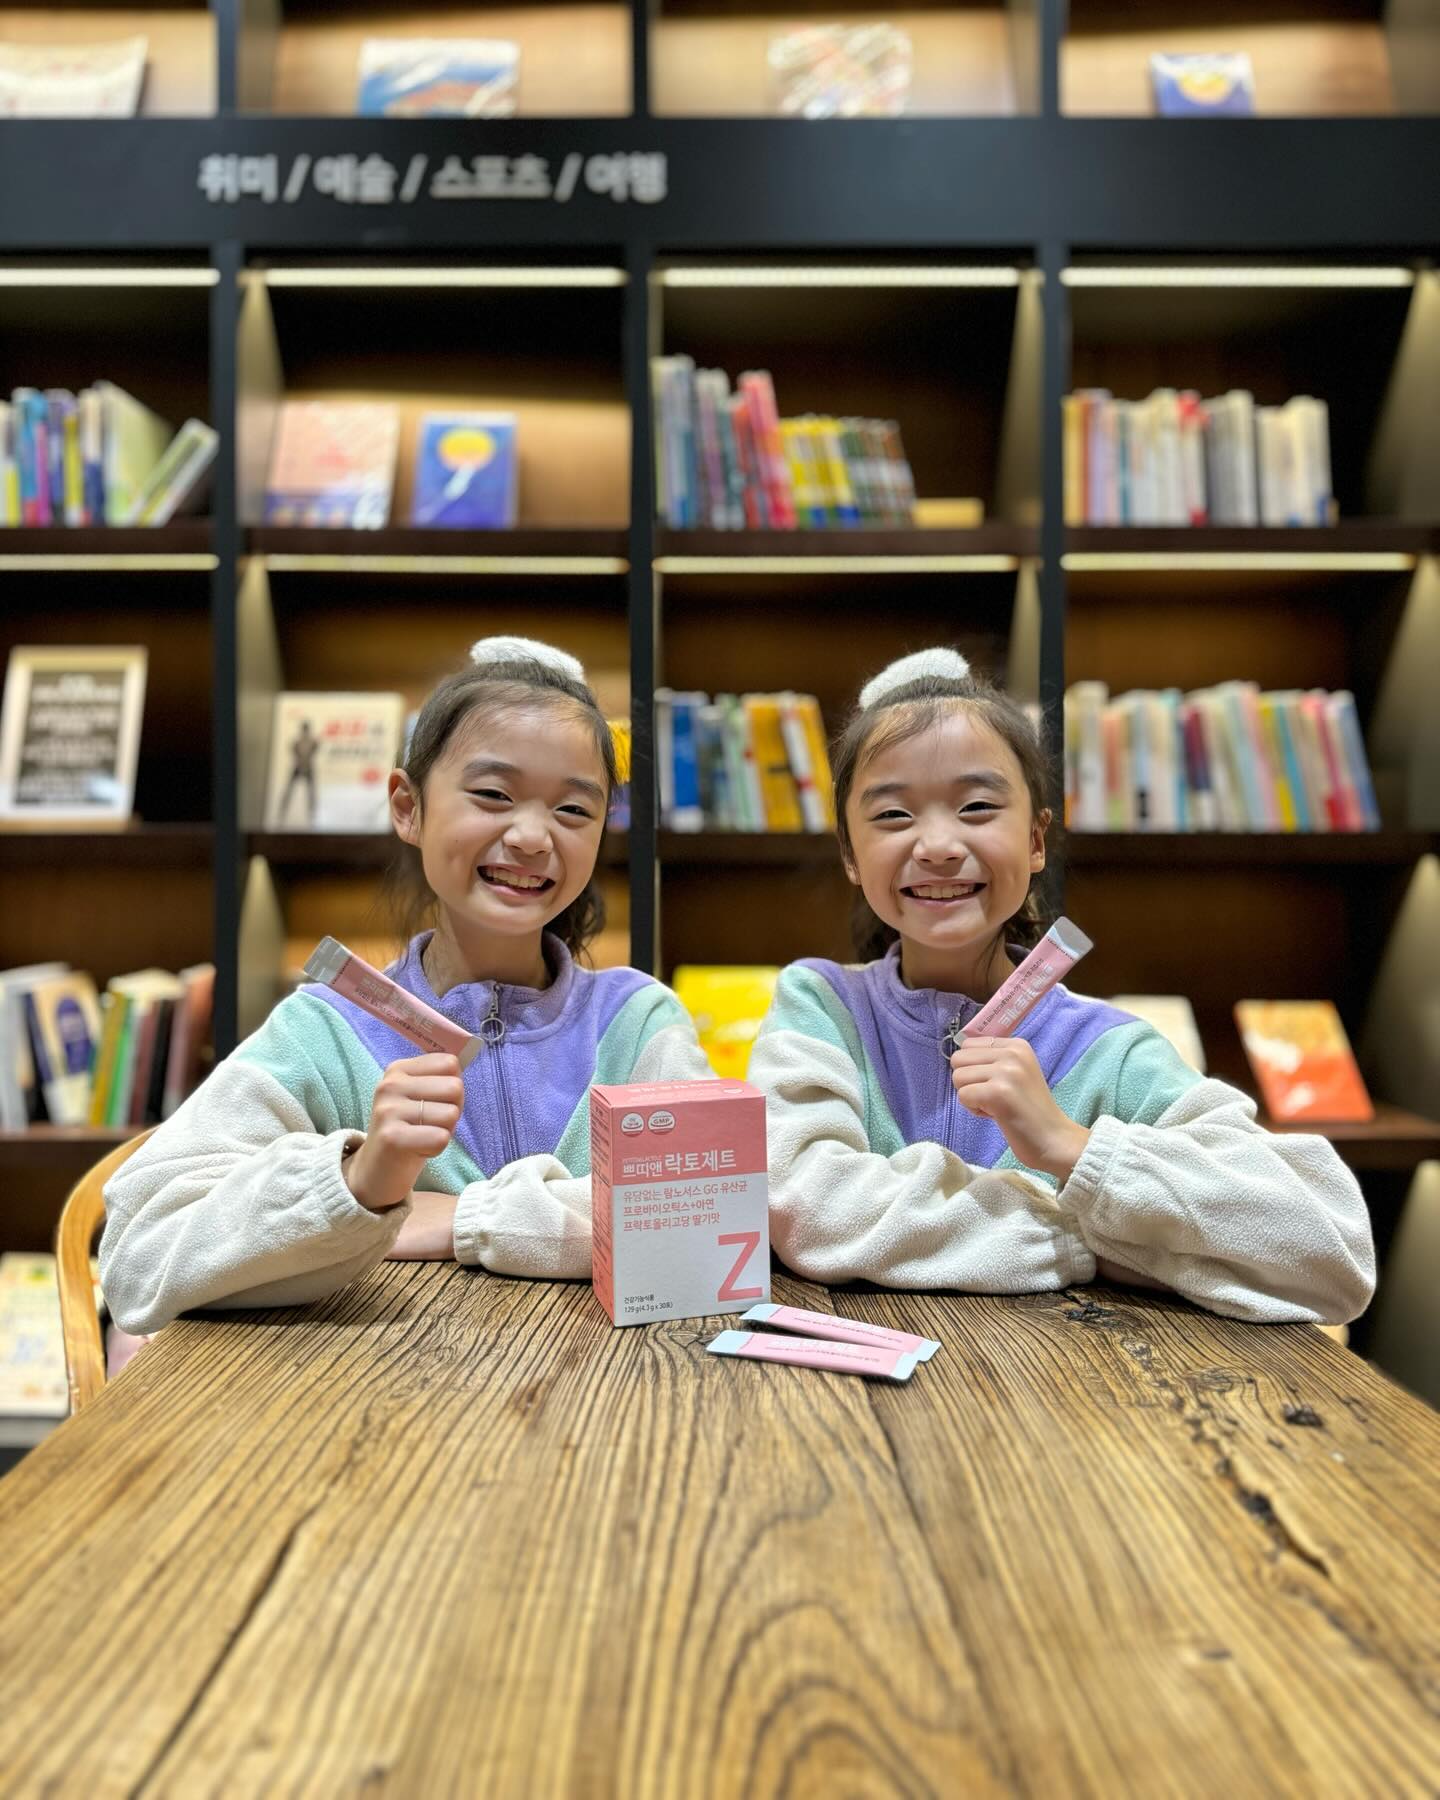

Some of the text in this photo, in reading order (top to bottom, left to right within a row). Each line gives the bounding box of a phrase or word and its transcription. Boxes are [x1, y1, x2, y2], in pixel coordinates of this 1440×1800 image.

[653, 1117, 671, 1125] GMP
[665, 1150, 736, 1174] 락토제트
[624, 1180, 748, 1202] 유당없는 람노서스 GG 유산균
[624, 1212, 720, 1232] 프락토올리고당 딸기맛
[717, 1231, 763, 1302] Z
